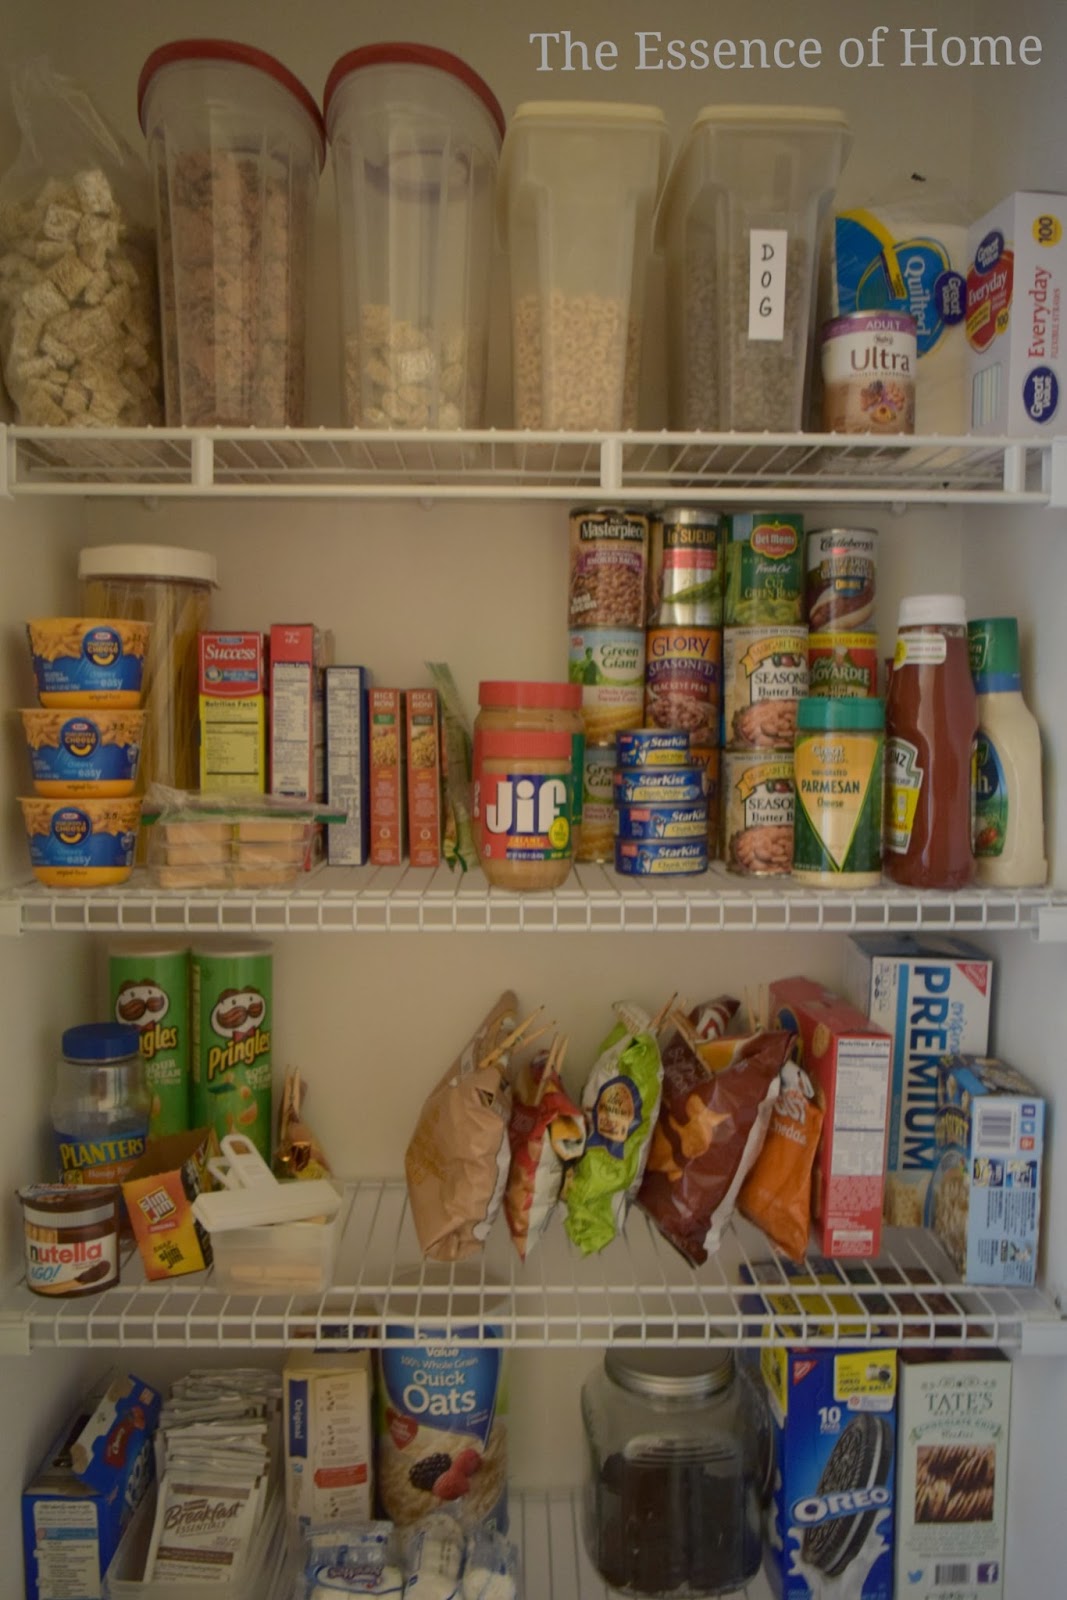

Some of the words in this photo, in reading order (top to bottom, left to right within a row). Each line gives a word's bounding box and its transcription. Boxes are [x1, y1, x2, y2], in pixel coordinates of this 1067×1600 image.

[1038, 216, 1054, 244] 100
[759, 242, 776, 318] DOG
[968, 270, 1009, 308] Everyday
[904, 256, 932, 337] Quilted
[949, 276, 962, 316] Great
[1028, 266, 1054, 358] Everyday
[865, 320, 901, 331] ADULT
[850, 347, 910, 372] Ultra
[1030, 376, 1045, 418] Great
[581, 520, 643, 539] Masterpiec
[680, 529, 717, 544] SUEUR
[204, 643, 257, 661] Success
[600, 644, 640, 657] Green
[652, 636, 711, 657] GLORY
[601, 659, 637, 670] Giant
[648, 658, 714, 677] SEASONED
[101, 679, 123, 690] easy
[753, 671, 809, 686] SEASONE
[373, 692, 394, 700] RICE
[411, 692, 432, 700] RICE
[757, 687, 789, 697] Butter
[205, 700, 237, 709] Nutrition
[238, 700, 258, 709] Facts
[77, 769, 102, 780] easy
[586, 761, 614, 776] Gre
[588, 776, 614, 787] Gia
[639, 773, 686, 787] StarKist
[801, 779, 860, 794] PARMESAN
[486, 778, 567, 834] Jif
[748, 799, 794, 811] SEASO
[751, 812, 783, 823] Butter
[66, 856, 92, 867] easy
[656, 846, 700, 859] StarKist
[140, 1023, 178, 1059] gles
[208, 1029, 271, 1081] Pringles
[903, 965, 951, 1172] PREMIUM
[60, 1137, 145, 1169] PLANTERS
[28, 1241, 103, 1265] nutella
[425, 1348, 460, 1358] Value
[412, 1369, 465, 1390] Quick
[403, 1385, 478, 1416] Oats
[925, 1391, 994, 1414] TATE'S
[293, 1398, 305, 1440] Original
[817, 1407, 842, 1425] 10
[793, 1487, 890, 1523] OREO
[164, 1500, 244, 1531] Breakfast
